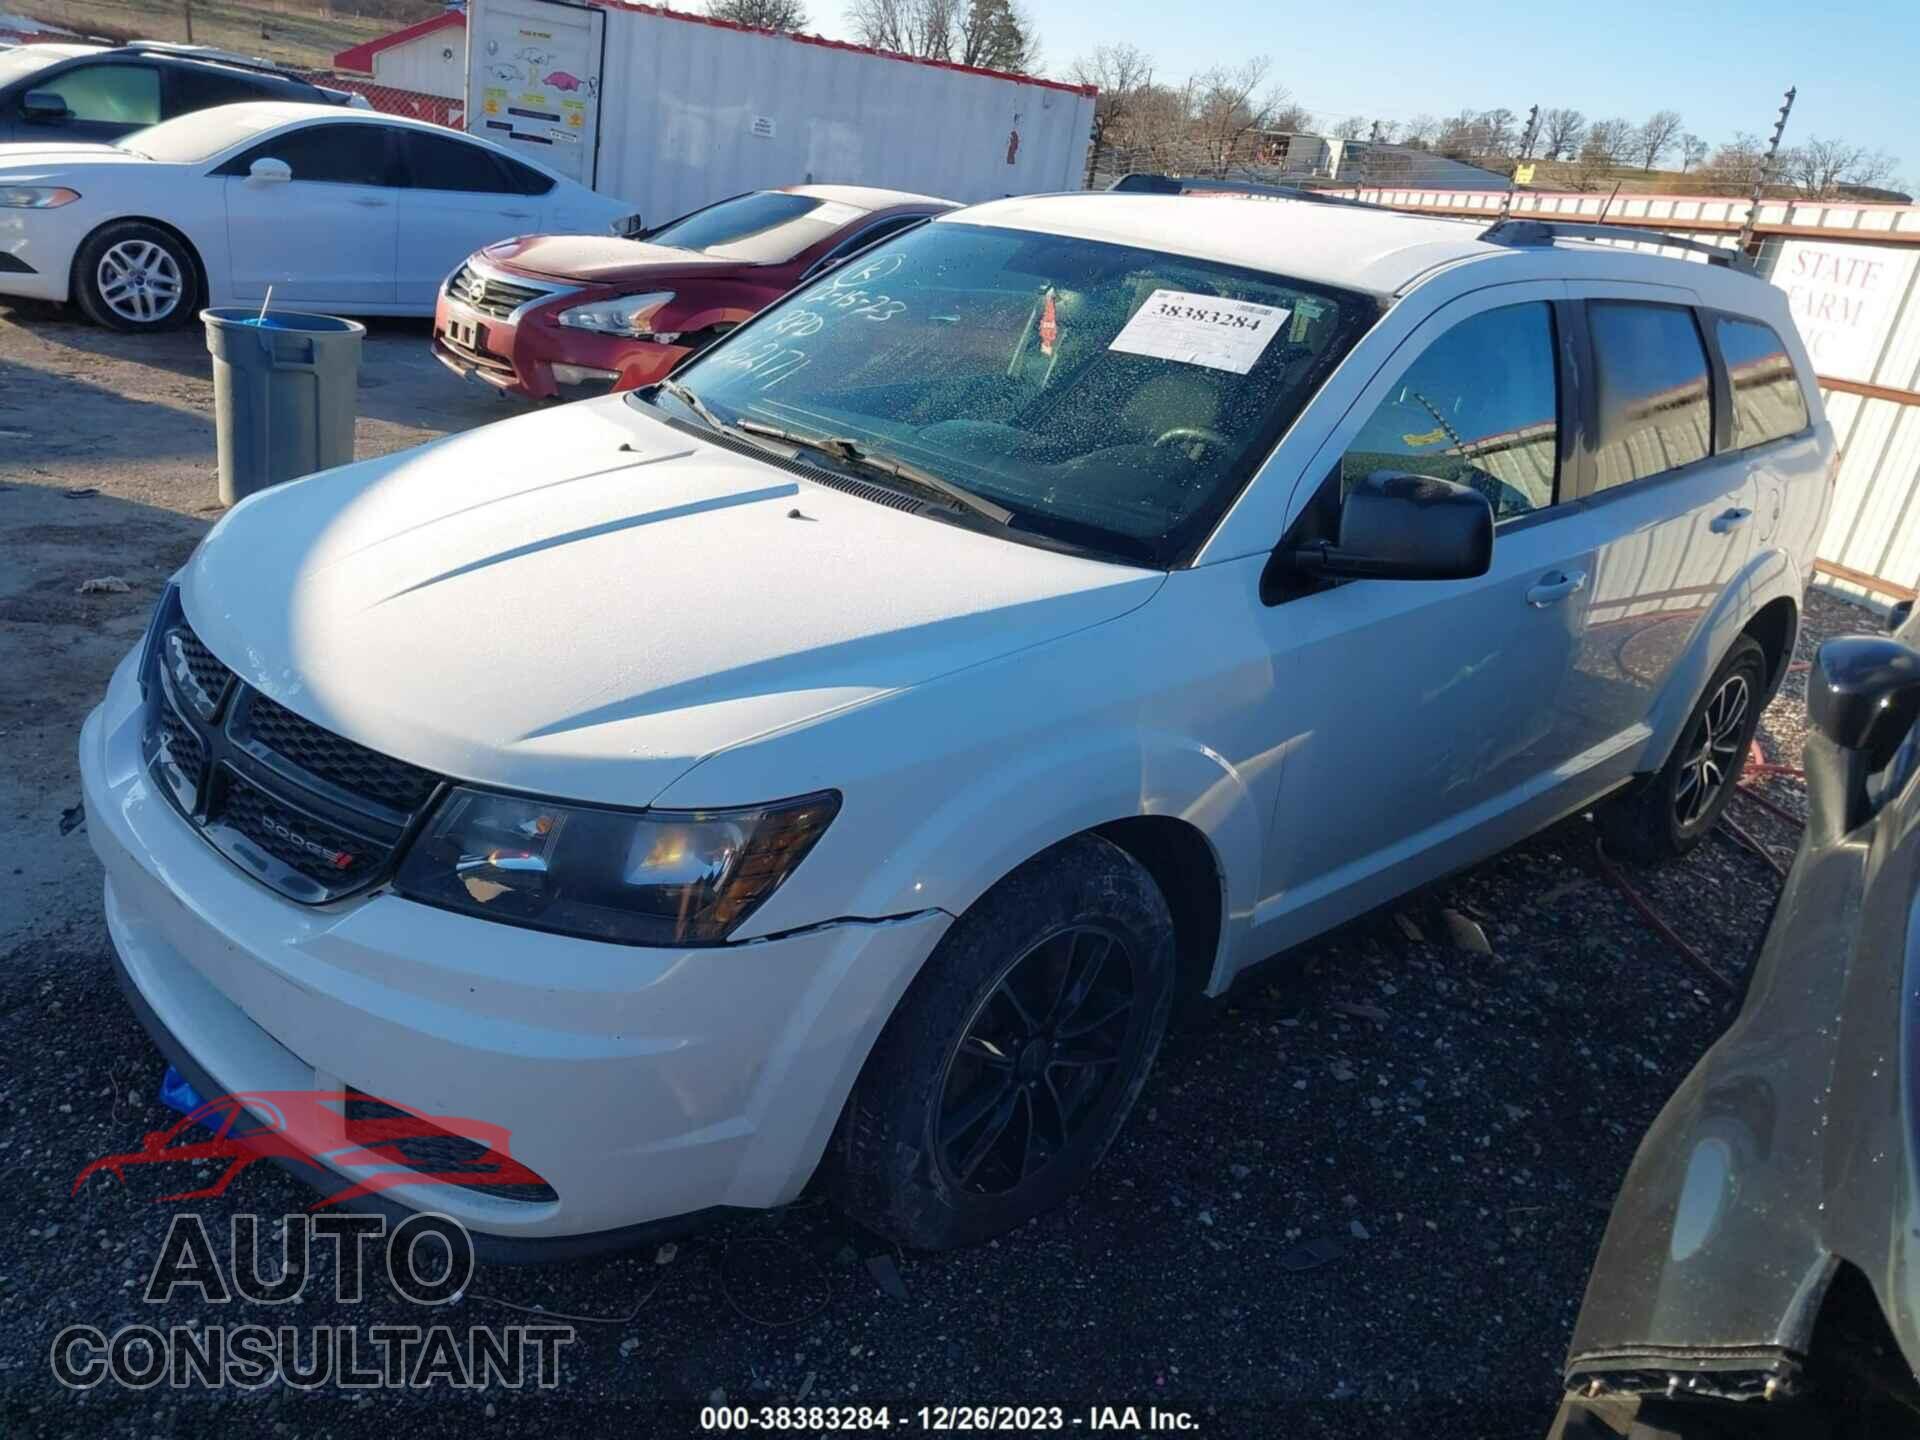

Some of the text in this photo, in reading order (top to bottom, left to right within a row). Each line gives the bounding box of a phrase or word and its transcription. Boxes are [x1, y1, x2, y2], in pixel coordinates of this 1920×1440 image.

[1792, 250, 1884, 288] STATE
[1151, 303, 1262, 332] 38383284
[262, 815, 337, 864] DODGE
